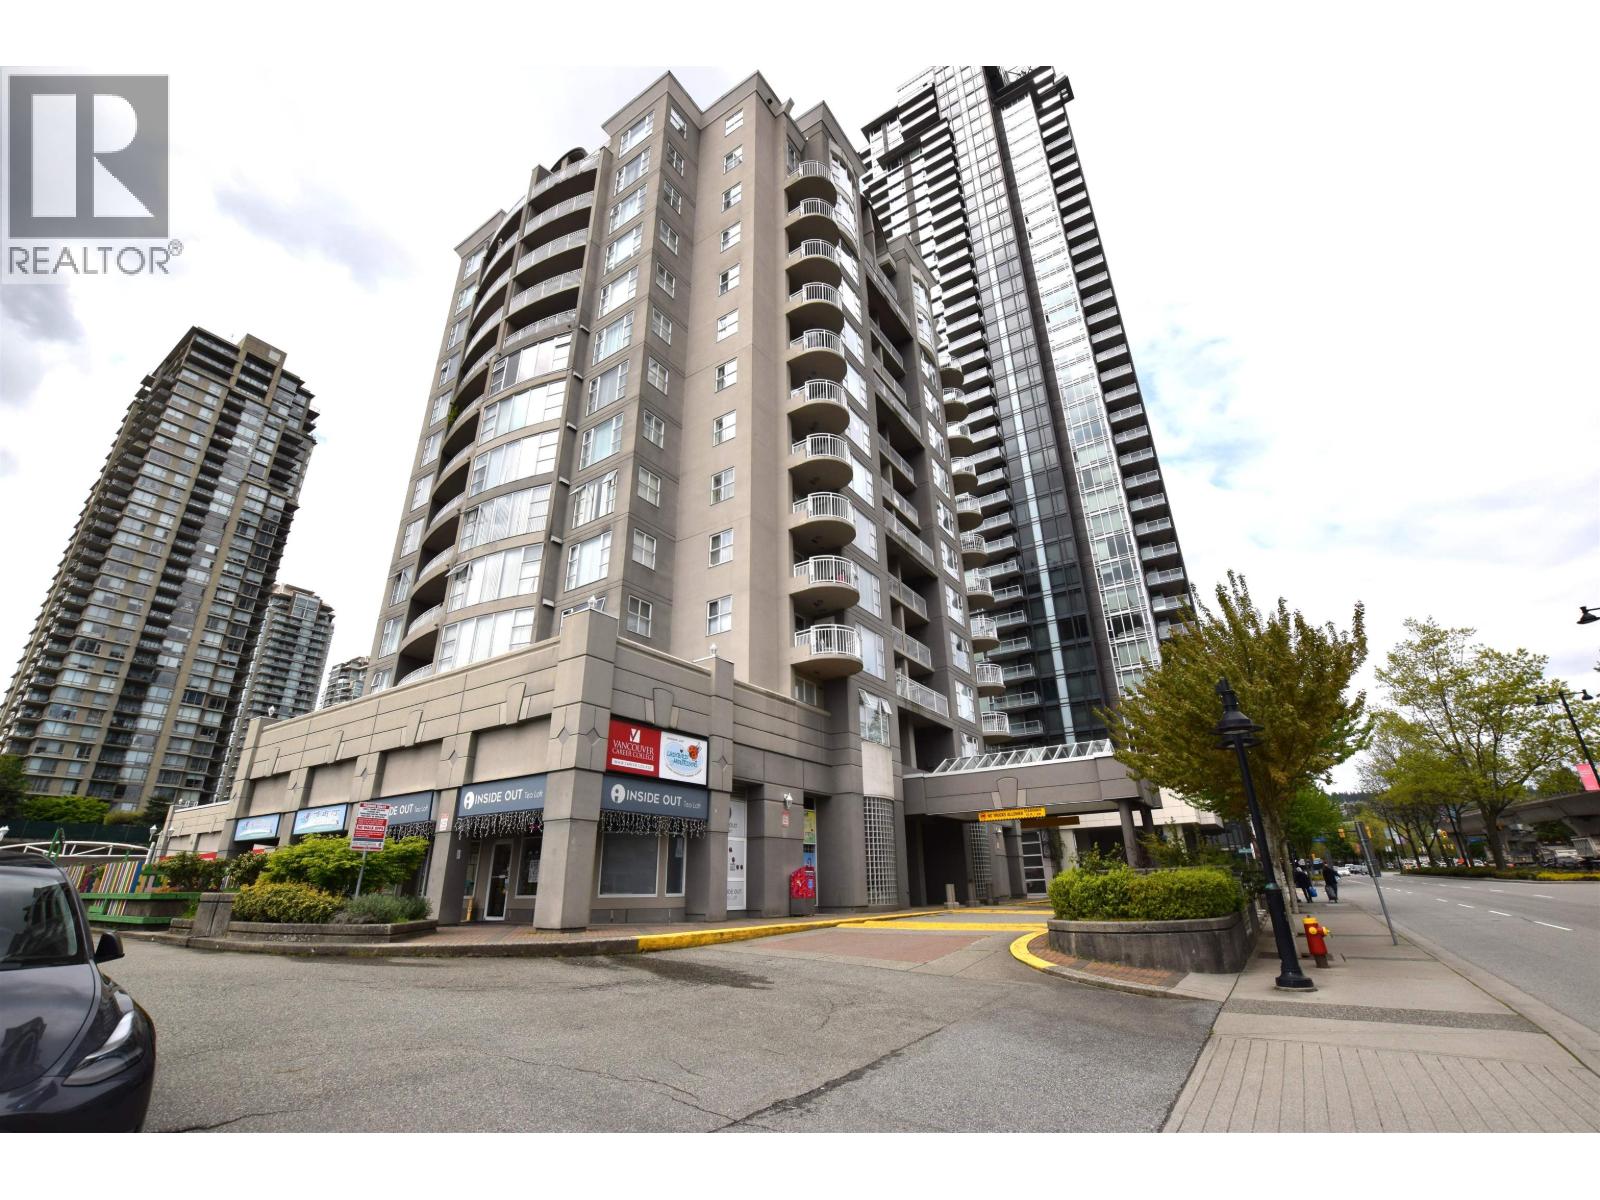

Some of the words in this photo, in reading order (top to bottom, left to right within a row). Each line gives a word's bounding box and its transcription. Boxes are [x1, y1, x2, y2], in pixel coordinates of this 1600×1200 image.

[612, 747, 632, 758] CAREER
[632, 750, 655, 761] COLLEGE
[613, 739, 654, 755] VANCOUVER
[475, 791, 502, 805] INSIDE
[505, 789, 523, 801] OUT
[627, 789, 660, 804] INSIDE
[662, 795, 682, 807] OUT
[399, 803, 414, 814] OUT
